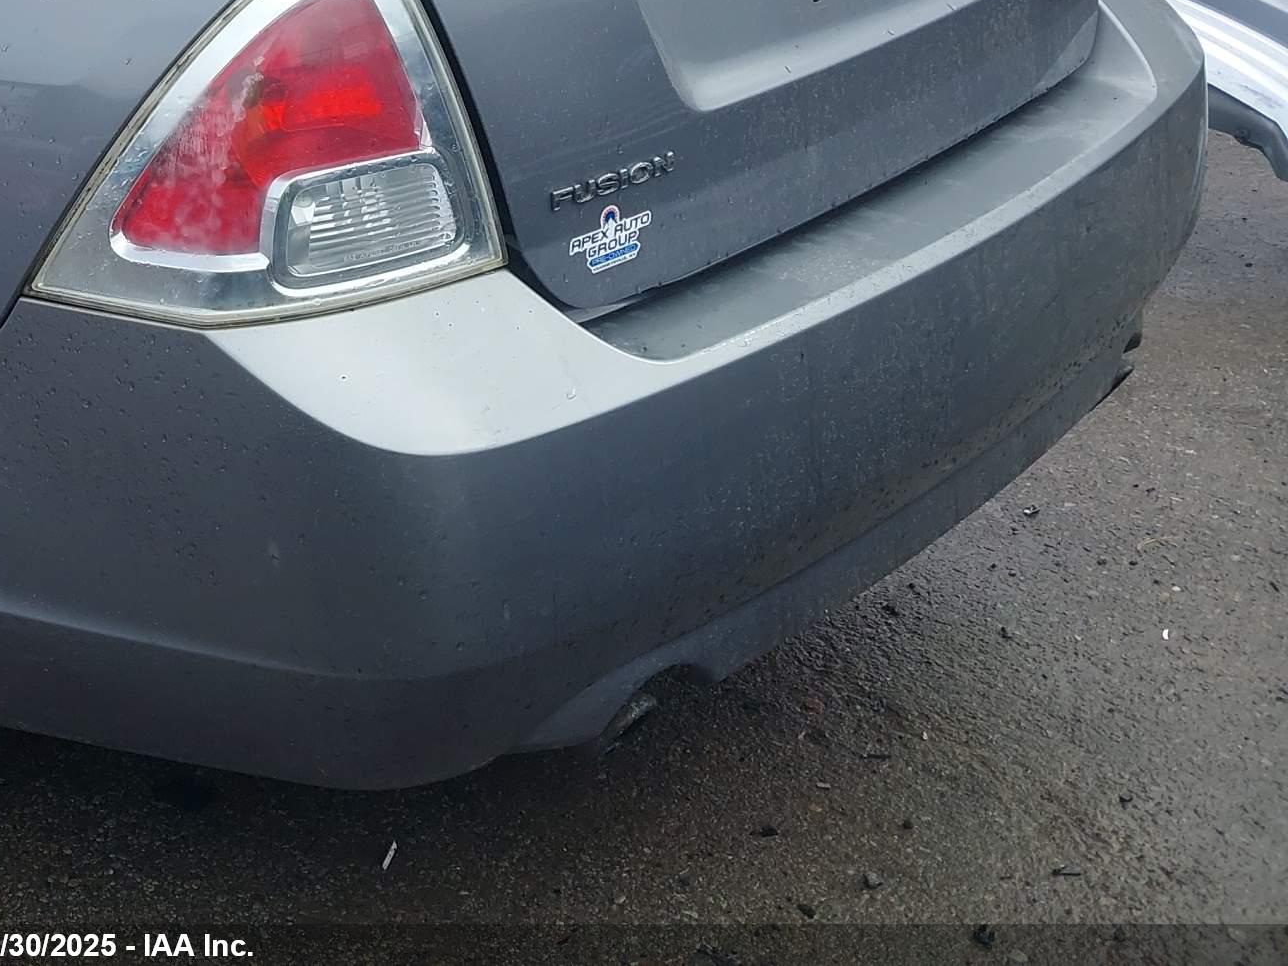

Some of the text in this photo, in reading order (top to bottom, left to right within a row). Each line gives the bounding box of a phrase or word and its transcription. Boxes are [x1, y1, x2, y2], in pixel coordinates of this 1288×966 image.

[551, 150, 675, 211] FUSION
[571, 213, 650, 253] APEX AUTO
[588, 230, 638, 258] GROUP
[590, 242, 639, 266] PRE-OWNED
